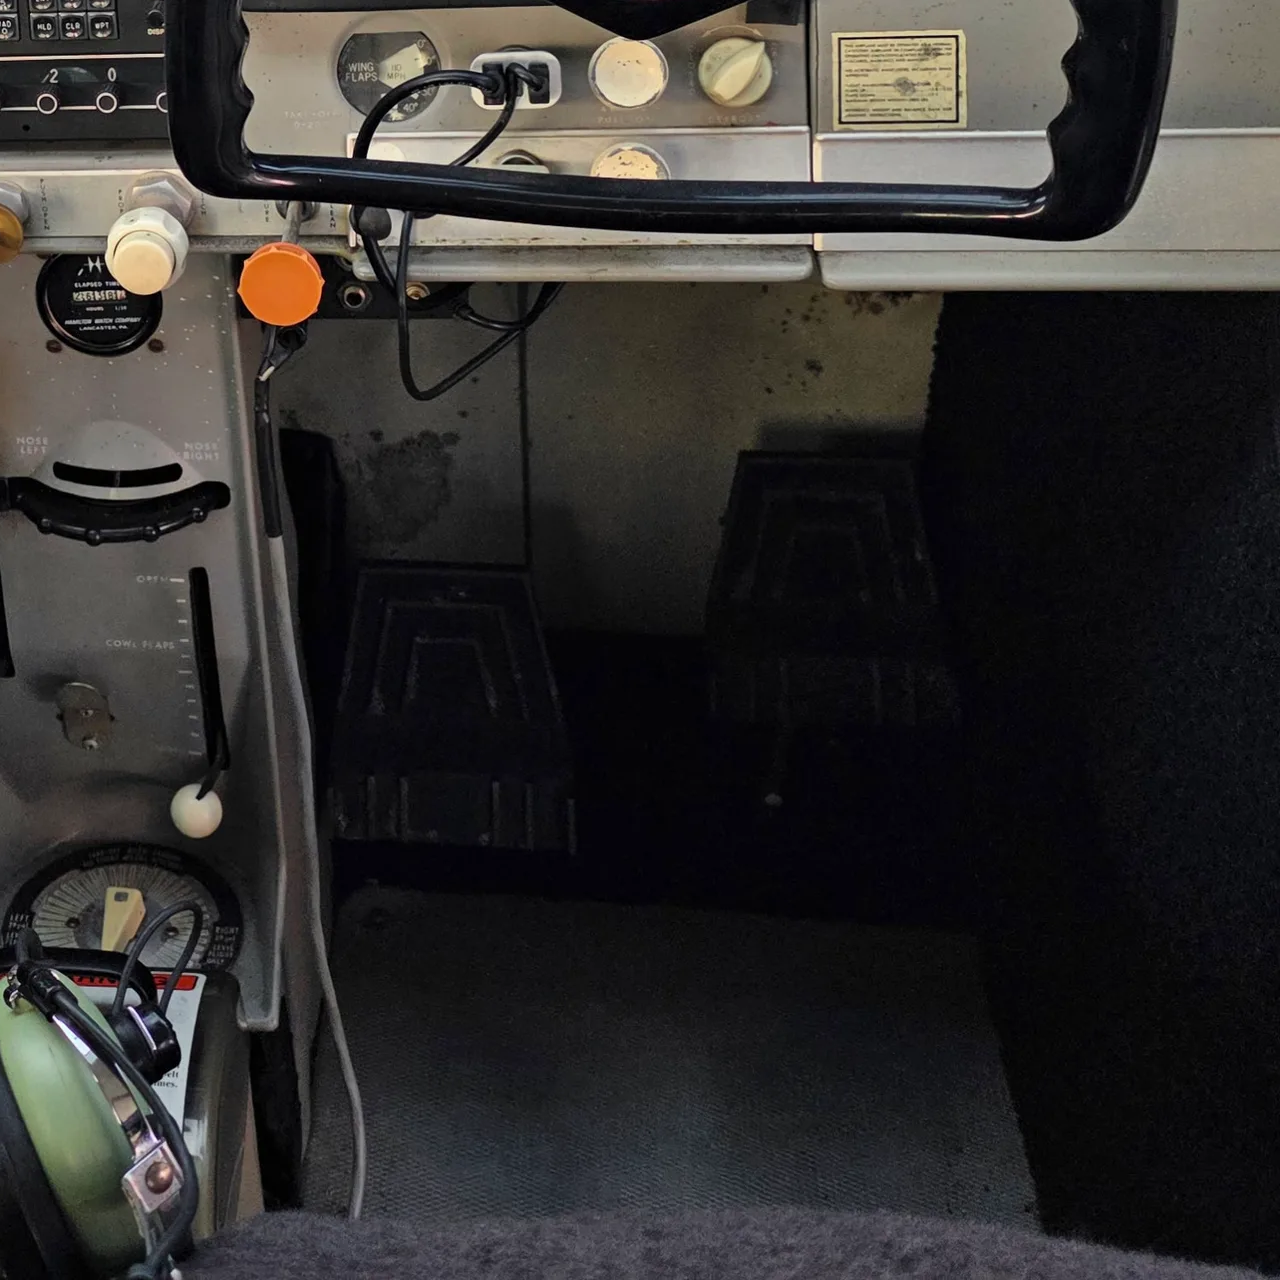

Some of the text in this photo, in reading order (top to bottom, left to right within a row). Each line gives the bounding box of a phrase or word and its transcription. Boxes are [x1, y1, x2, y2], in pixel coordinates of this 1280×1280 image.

[348, 62, 374, 73] WING
[345, 71, 378, 82] FLAPS
[387, 72, 406, 80] MPH
[16, 437, 49, 446] NOSE
[20, 446, 46, 455] LEFT
[184, 442, 218, 451] NOSE
[106, 639, 175, 650] COWL FLAPS
